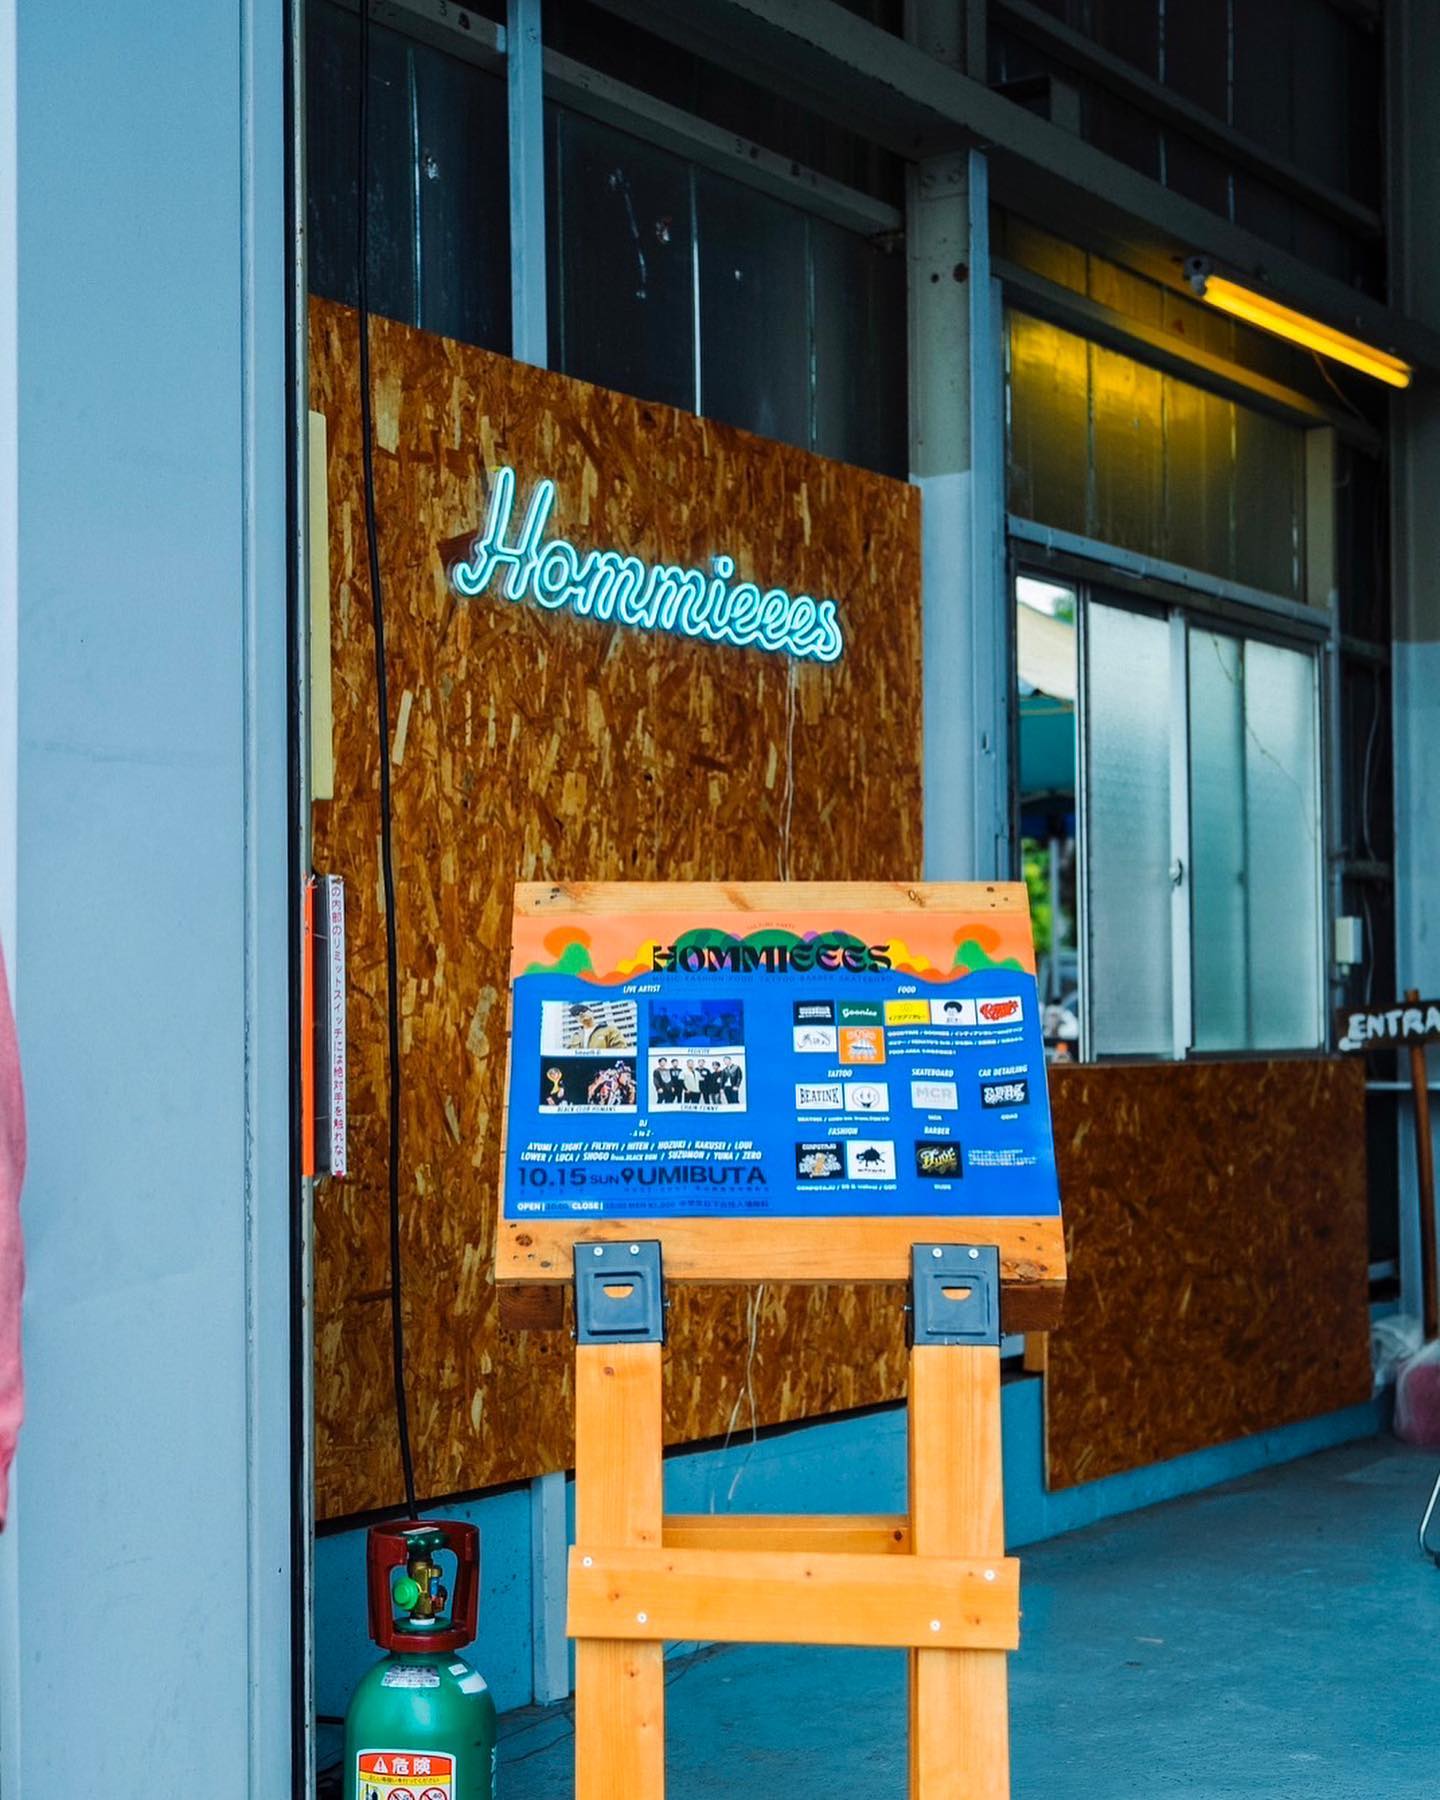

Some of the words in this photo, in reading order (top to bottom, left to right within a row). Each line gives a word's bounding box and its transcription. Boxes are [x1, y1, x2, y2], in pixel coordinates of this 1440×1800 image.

[454, 466, 844, 662] Hommieees
[652, 943, 892, 974] HOMMIEEES
[623, 985, 638, 994] LIVE
[638, 985, 661, 993] ARTIST
[897, 985, 917, 994] FOOD
[828, 1069, 853, 1078] TATTOO
[911, 1068, 954, 1078] SKATEBOARD
[978, 1068, 992, 1077] CAR
[993, 1064, 1028, 1076] DETAILING
[639, 1119, 648, 1127] DJ
[828, 1127, 858, 1136] FASHION
[924, 1126, 950, 1135] BARBER
[527, 1142, 553, 1151] AYUMI
[521, 1152, 547, 1162] LOWER
[556, 1153, 574, 1162] LUCA
[742, 1151, 762, 1160] ZERO
[518, 1167, 587, 1187] 10.15
[590, 1174, 620, 1185] SUN
[637, 1164, 767, 1185] UMIBUTA
[391, 1757, 431, 1775] 危険
